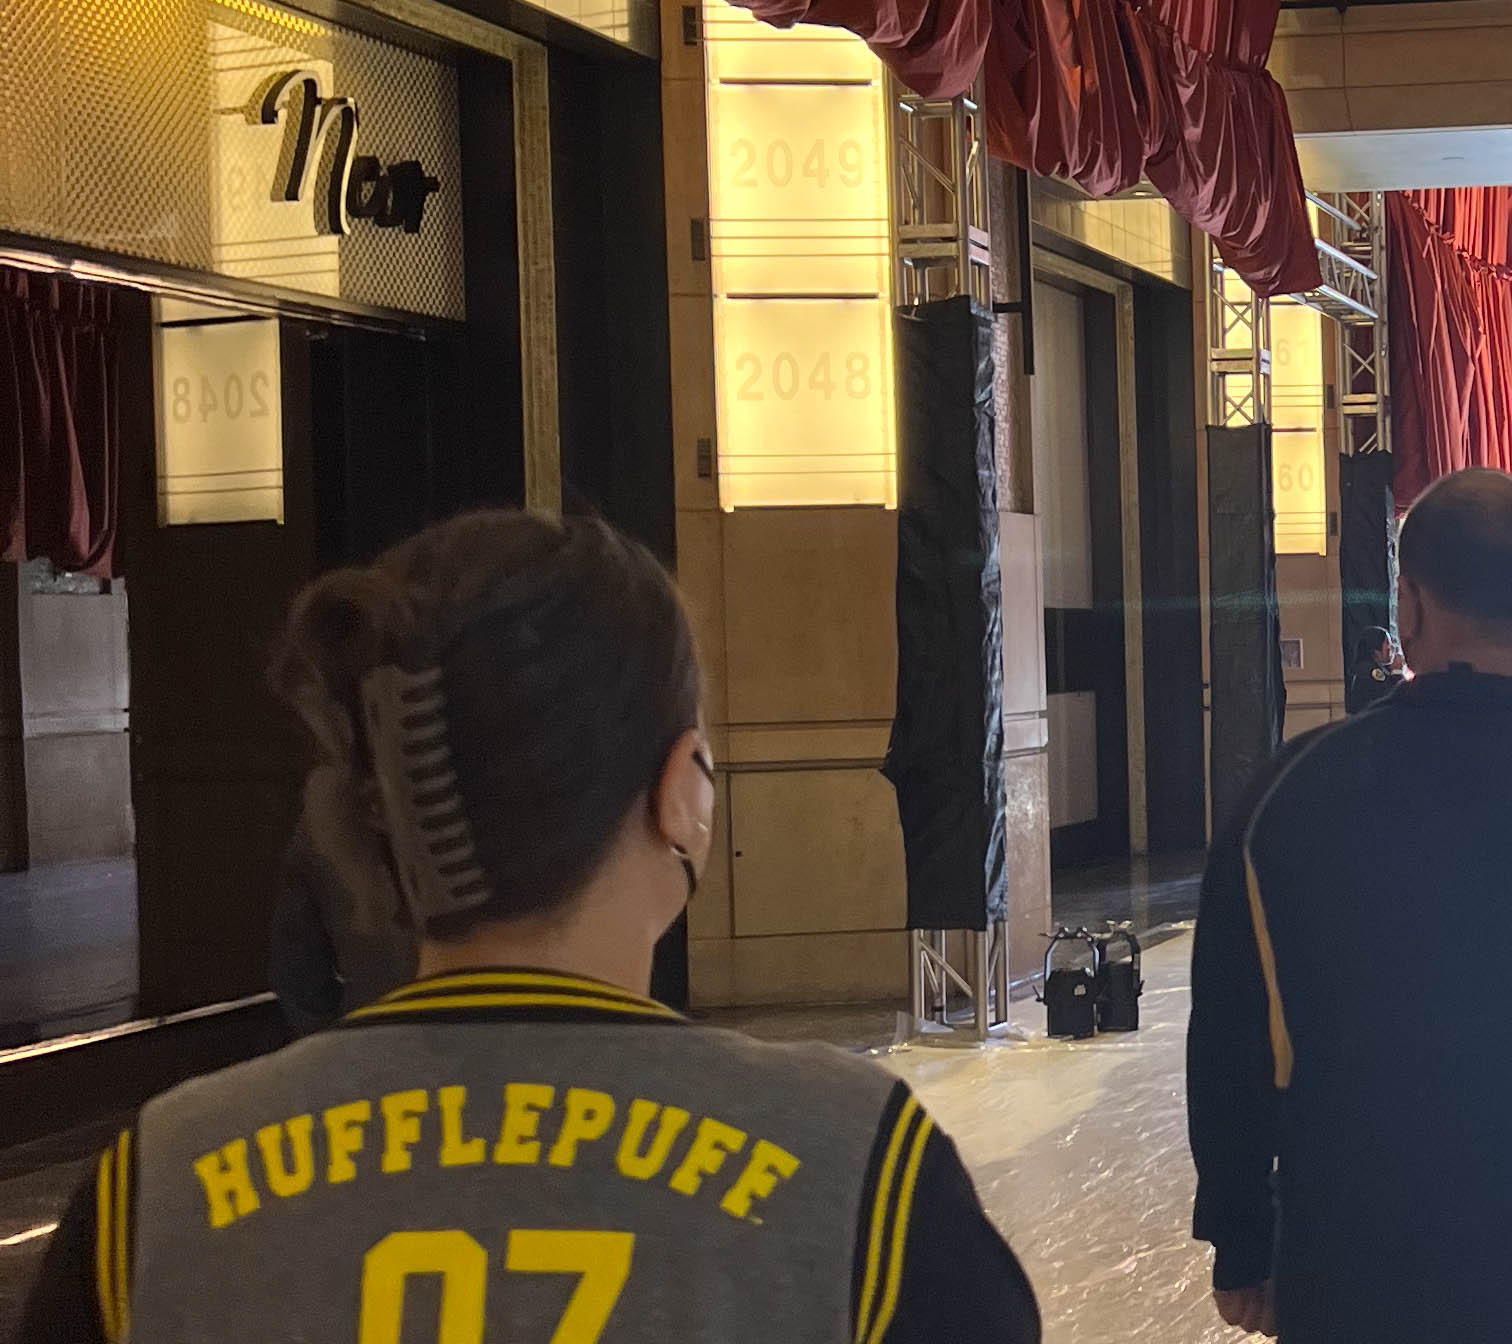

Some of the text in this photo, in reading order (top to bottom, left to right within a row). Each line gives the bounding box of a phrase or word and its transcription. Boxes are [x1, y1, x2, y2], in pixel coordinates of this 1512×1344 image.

[728, 136, 866, 189] 2049
[734, 350, 873, 402] 2048
[194, 1081, 802, 1230] HUFFLEPUFF
